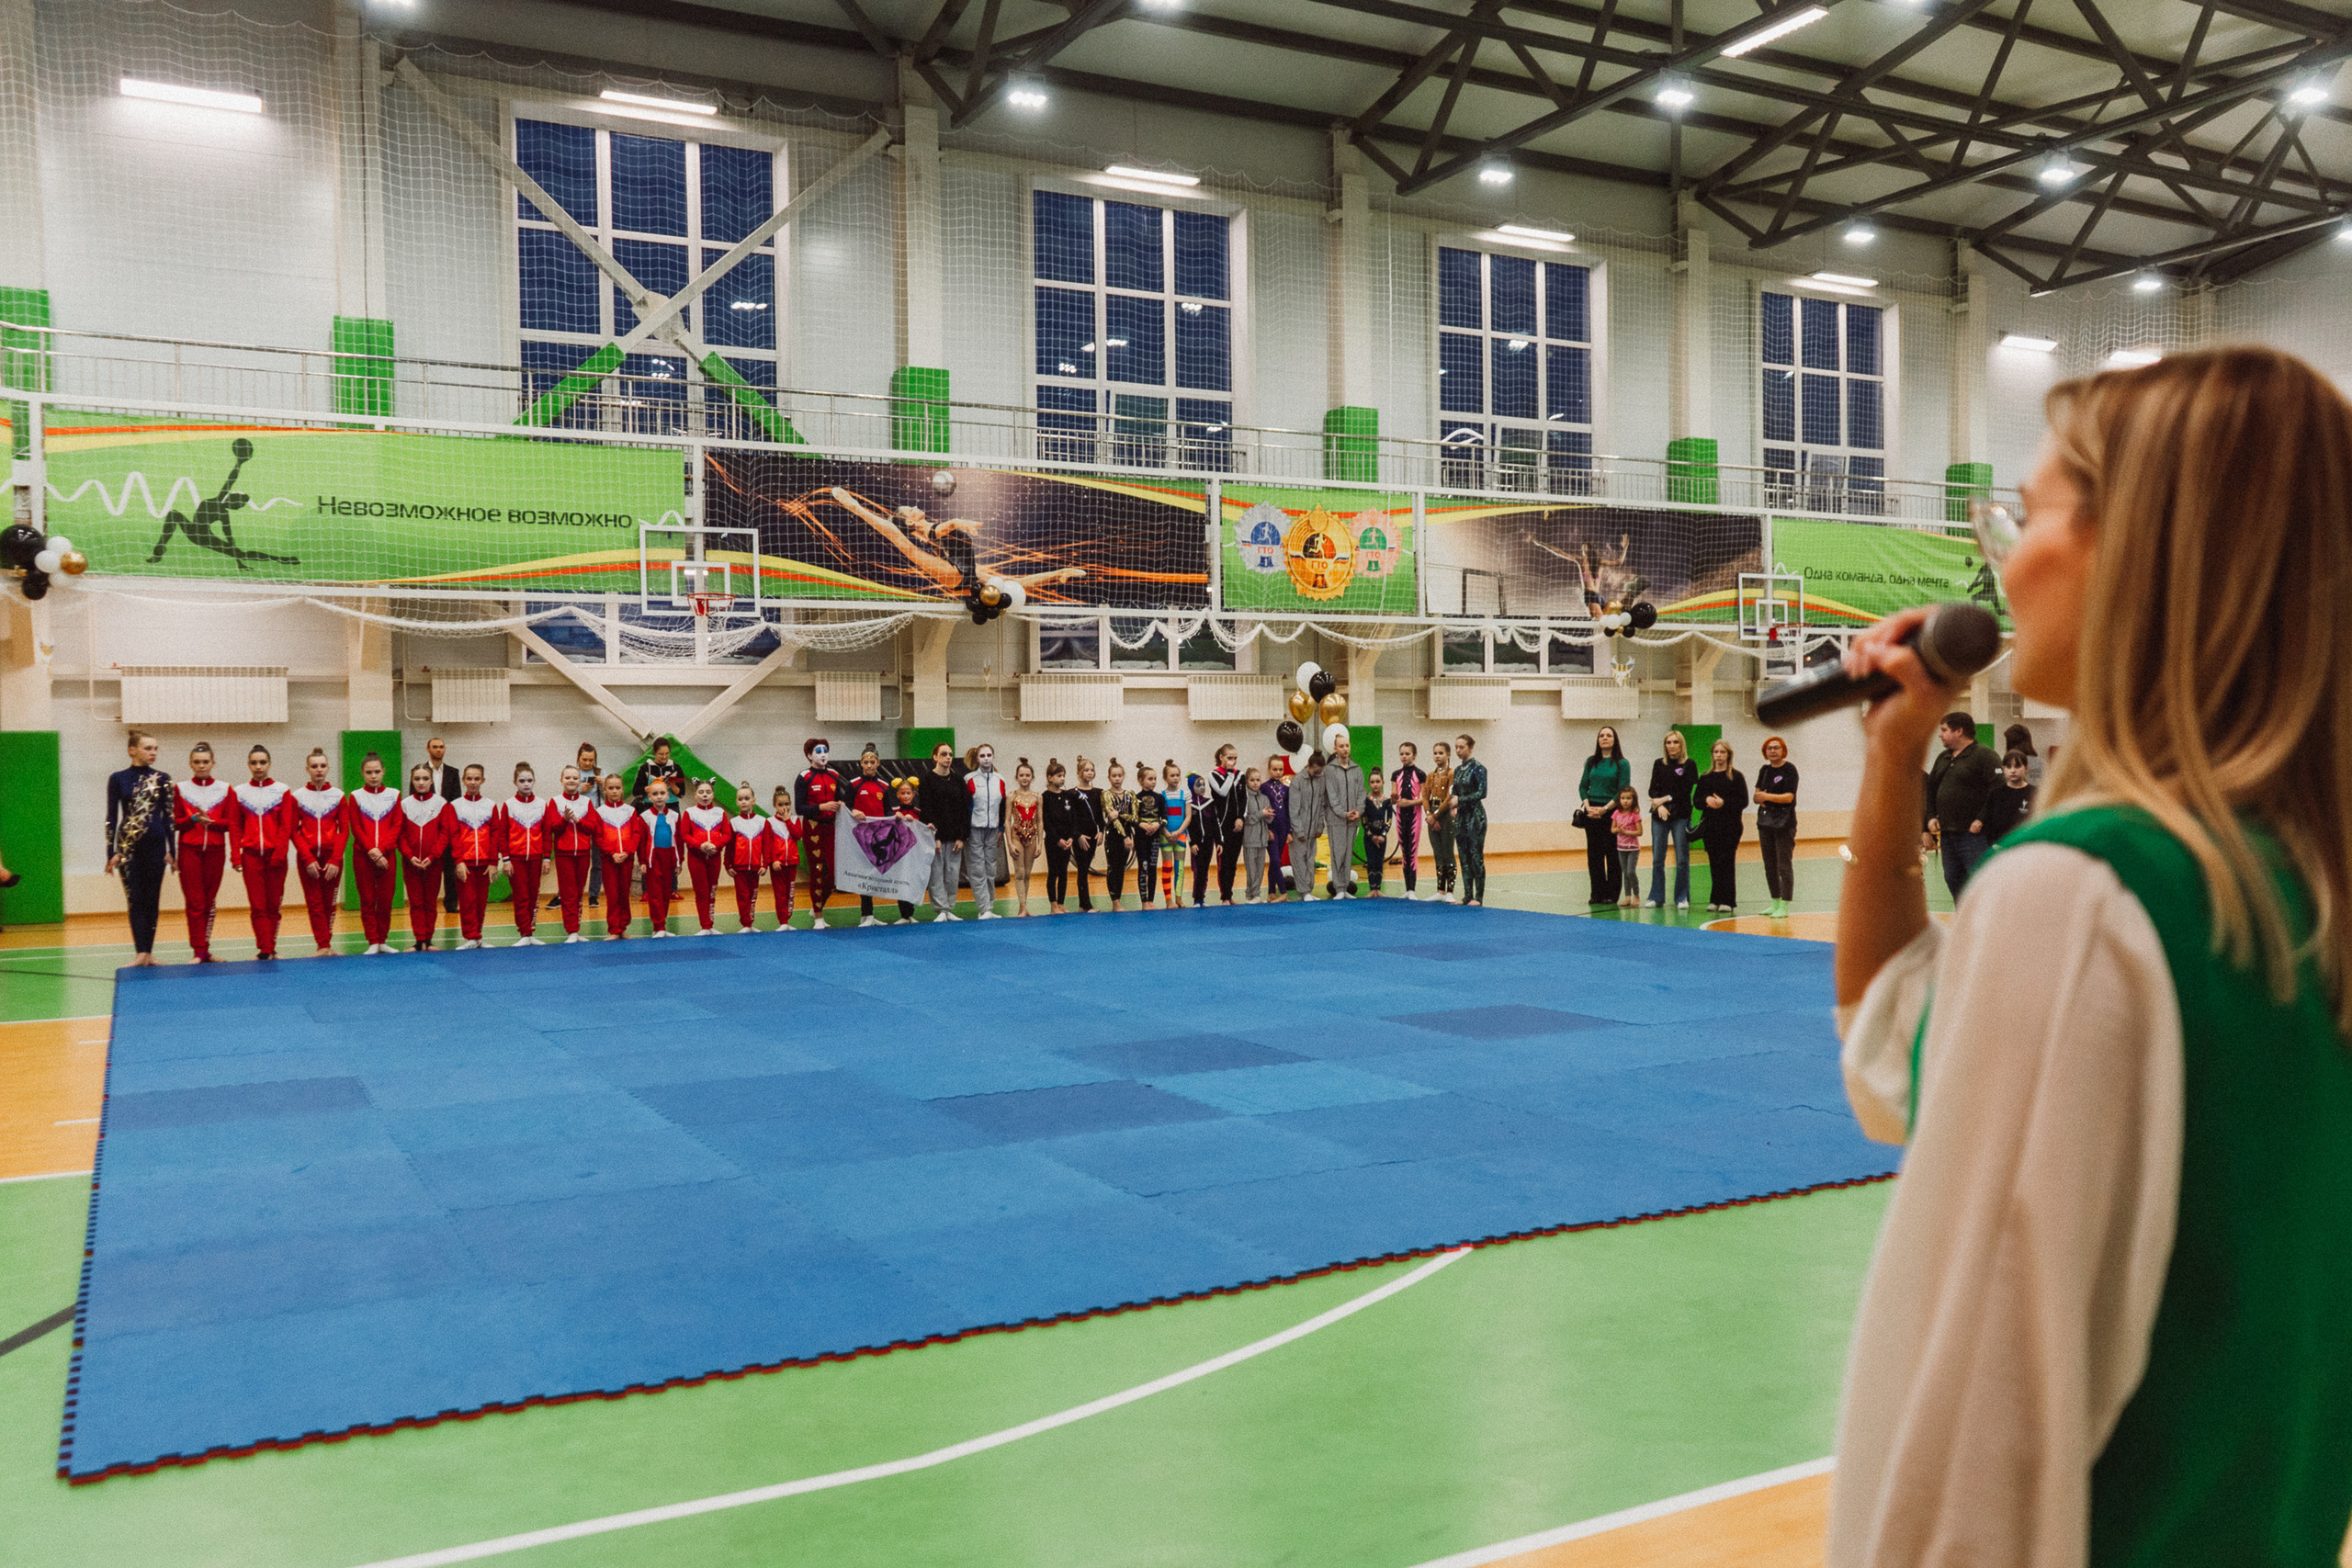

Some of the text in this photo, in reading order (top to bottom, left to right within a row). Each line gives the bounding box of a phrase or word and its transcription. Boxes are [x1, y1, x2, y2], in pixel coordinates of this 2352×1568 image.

[318, 495, 633, 529] Невозможное возможно
[1257, 546, 1274, 555] ГТО
[1365, 550, 1381, 559] ГТО
[1311, 560, 1329, 570] ГТО
[1804, 566, 1950, 588] Одна команда, одна мечта
